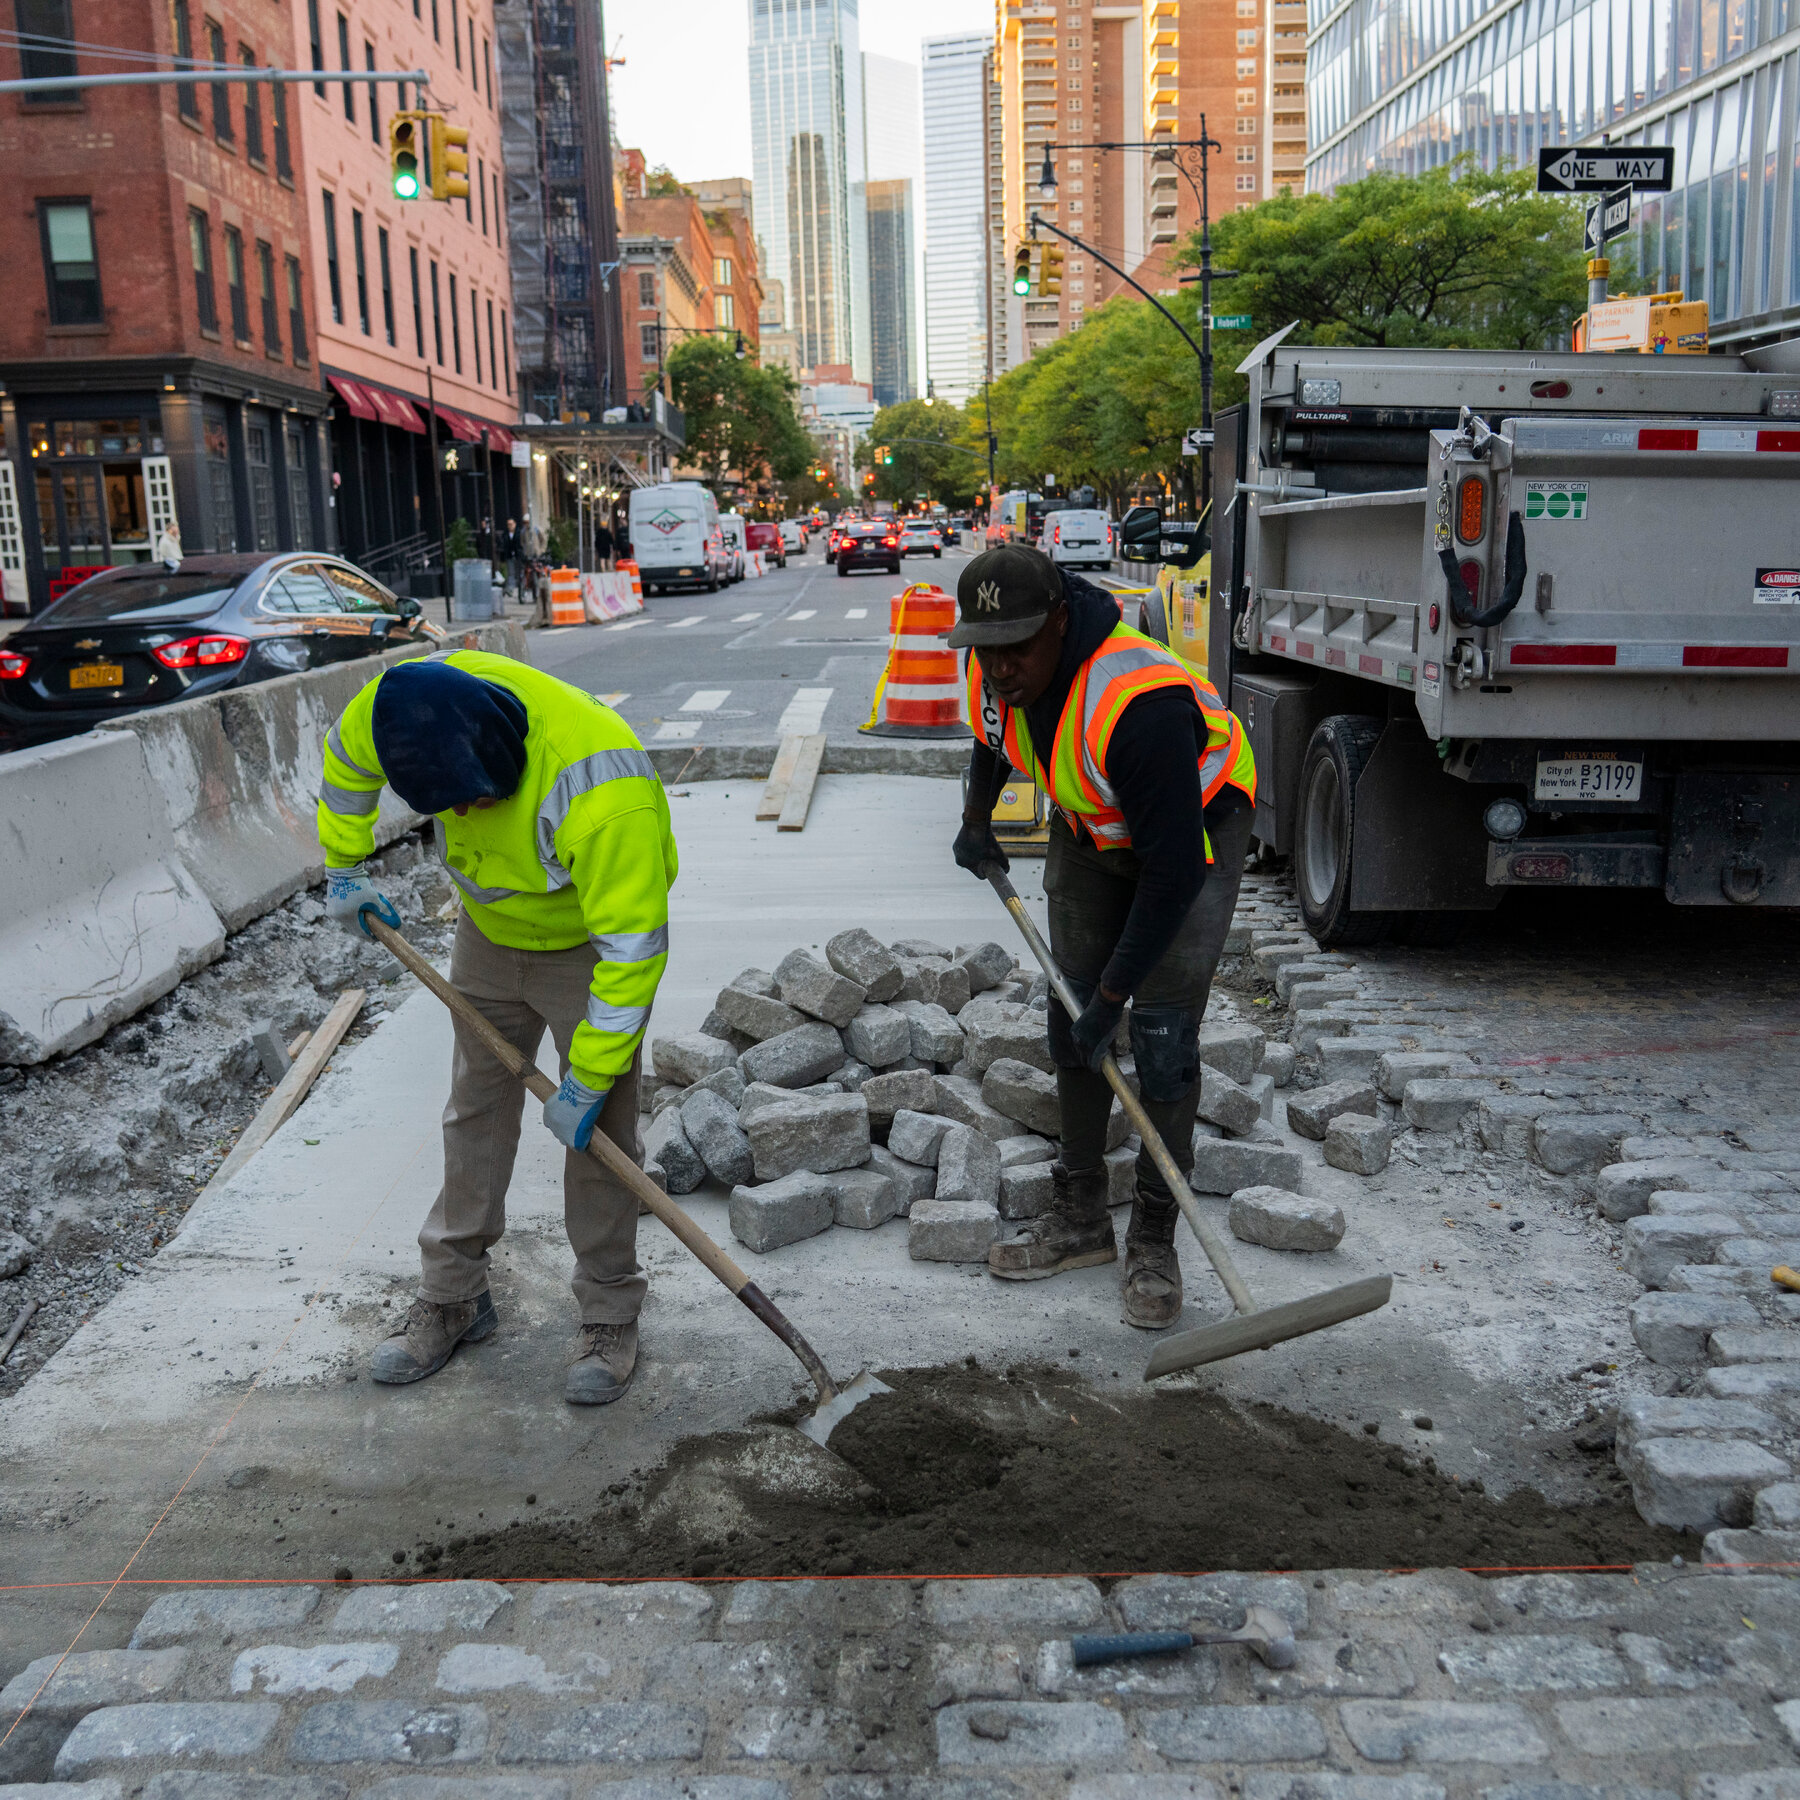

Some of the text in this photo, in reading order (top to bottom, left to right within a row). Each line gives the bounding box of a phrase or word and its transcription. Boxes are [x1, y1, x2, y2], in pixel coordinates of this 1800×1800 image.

[1560, 161, 1656, 178] ONE WAY
[1610, 202, 1626, 225] WAY
[1604, 304, 1635, 316] PARKING
[1295, 412, 1347, 421] PULLTARPS
[1526, 492, 1587, 518] DOT
[977, 580, 1000, 612] NY
[1564, 752, 1618, 760] NEW YORK
[1546, 766, 1573, 777] City of
[1540, 779, 1577, 787] New York
